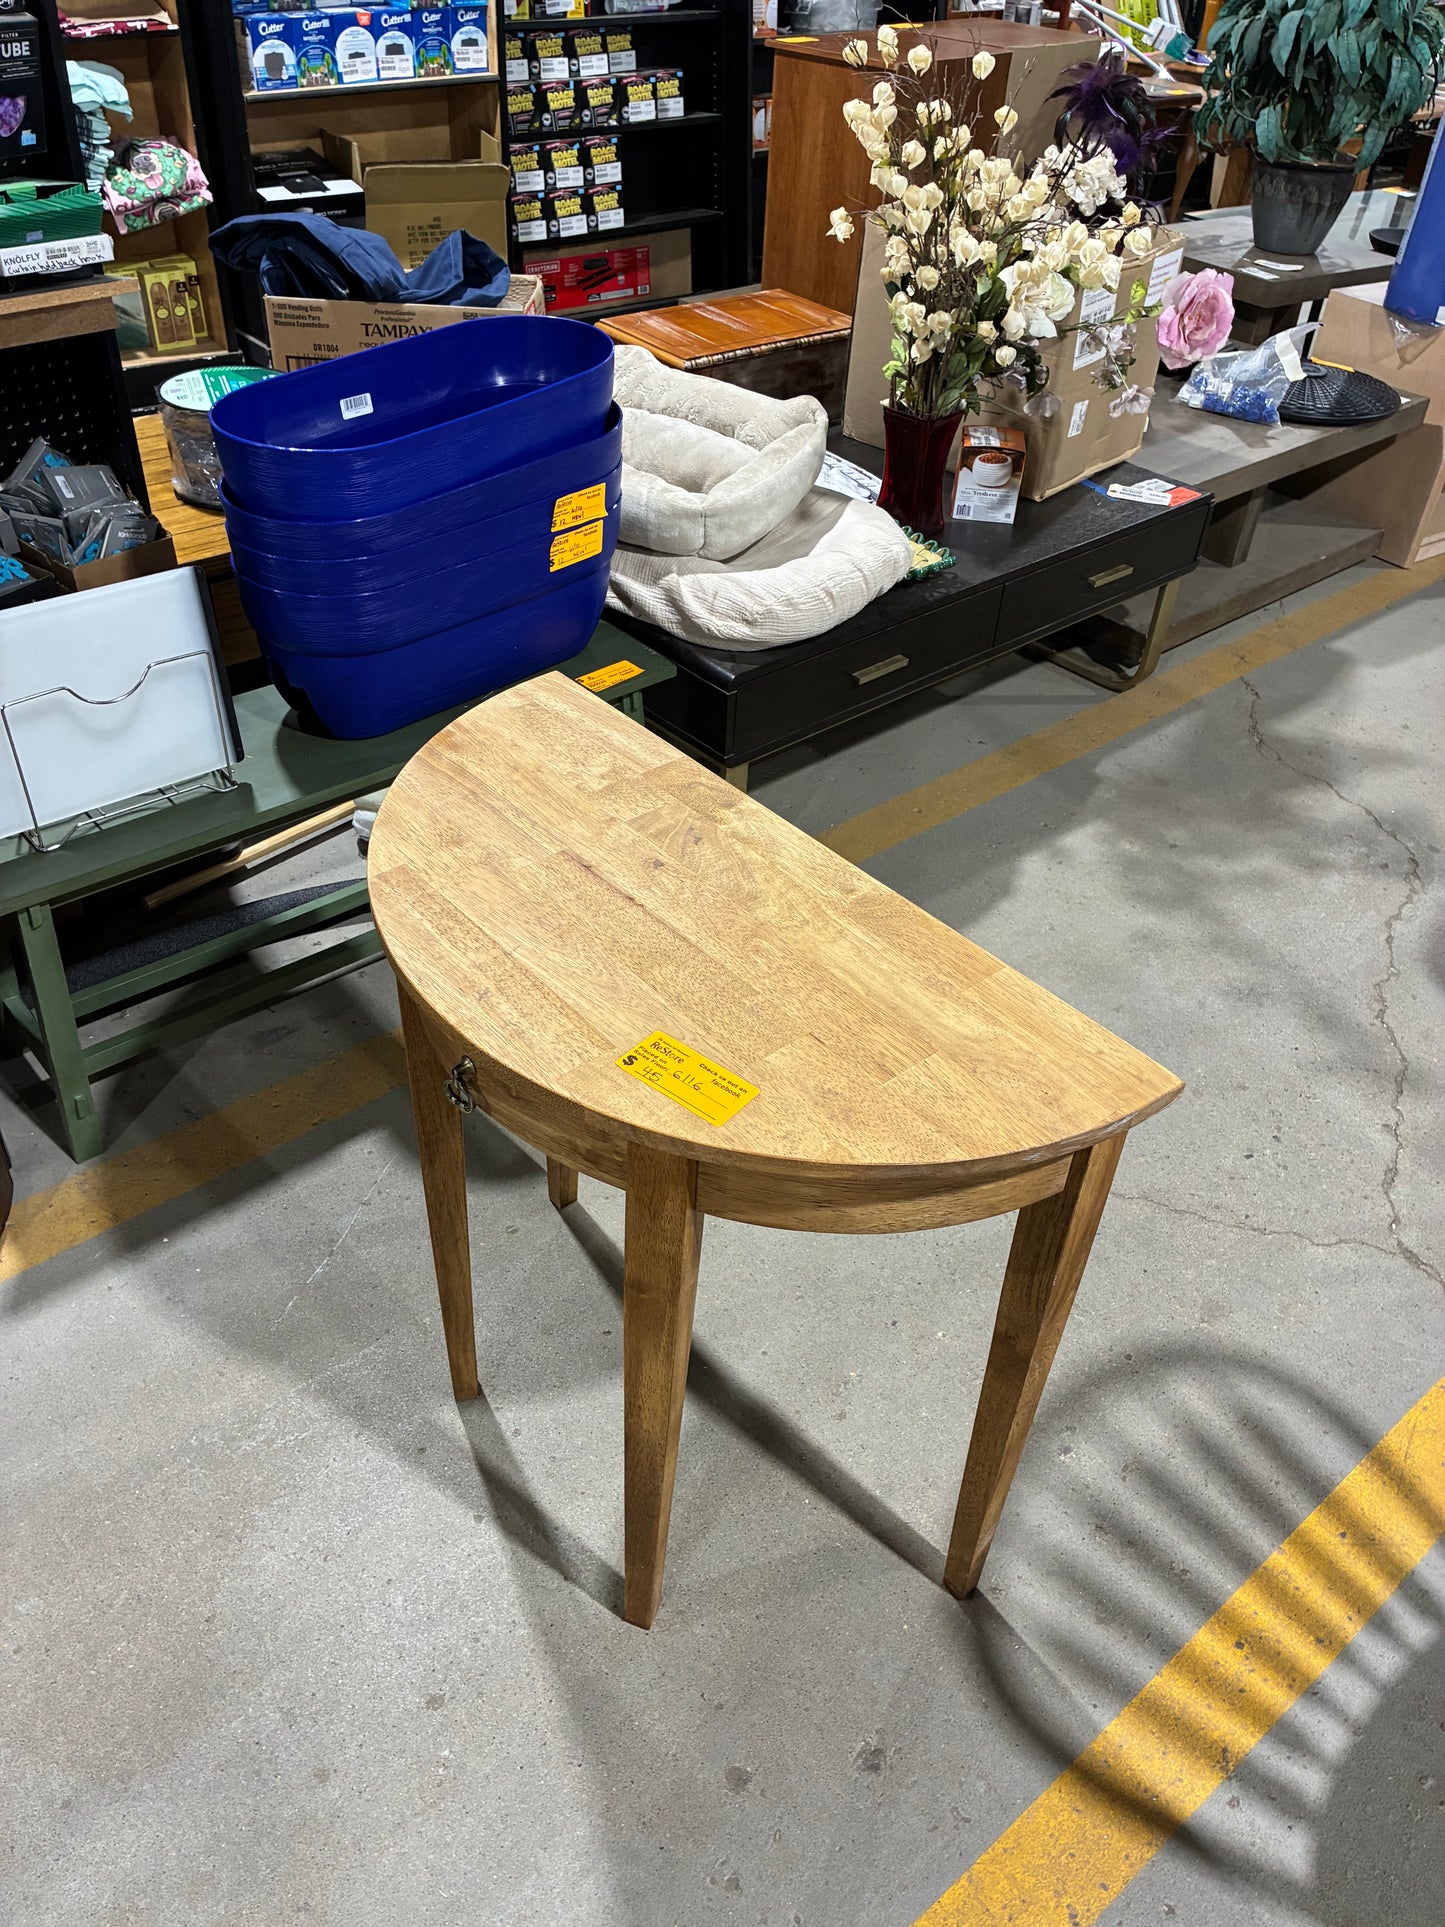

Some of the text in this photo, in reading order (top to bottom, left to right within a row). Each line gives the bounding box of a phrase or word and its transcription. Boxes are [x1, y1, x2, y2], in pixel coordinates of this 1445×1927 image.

[381, 13, 404, 27] Cutter
[422, 12, 442, 23] Cutter
[458, 9, 480, 22] Cutter
[258, 21, 285, 35] Cutter
[302, 19, 322, 31] Cutter
[536, 38, 563, 48] ROACH
[575, 36, 602, 46] ROACH
[0, 41, 30, 58] UBE
[538, 46, 564, 58] MOTEL
[577, 44, 603, 56] MOTEL
[587, 86, 613, 98] ROACH
[627, 83, 652, 95] ROACH
[547, 90, 574, 102] ROACH
[590, 95, 615, 107] MOTEL
[629, 92, 653, 102] MOTEL
[508, 102, 534, 114] MOTEL
[550, 98, 576, 111] MOTEL
[551, 149, 578, 162] ROACH
[590, 145, 616, 158] ROACH
[511, 153, 538, 165] ROACH
[554, 157, 579, 169] MOTEL
[593, 153, 617, 165] MOTEL
[513, 161, 539, 172] MOTEL
[554, 197, 581, 210] ROACH
[593, 192, 618, 204] ROACH
[514, 201, 541, 213] ROACH
[557, 206, 582, 217] MOTEL
[596, 200, 619, 212] MOTEL
[516, 210, 542, 222] MOTEL
[528, 264, 558, 274] CRAFTSMAN
[288, 304, 308, 312] Vending
[552, 520, 557, 528] $
[650, 1041, 684, 1064] ReStore
[622, 1055, 638, 1066] $
[699, 1063, 718, 1076] Check
[727, 1080, 739, 1089] out
[711, 1079, 741, 1098] facebook
